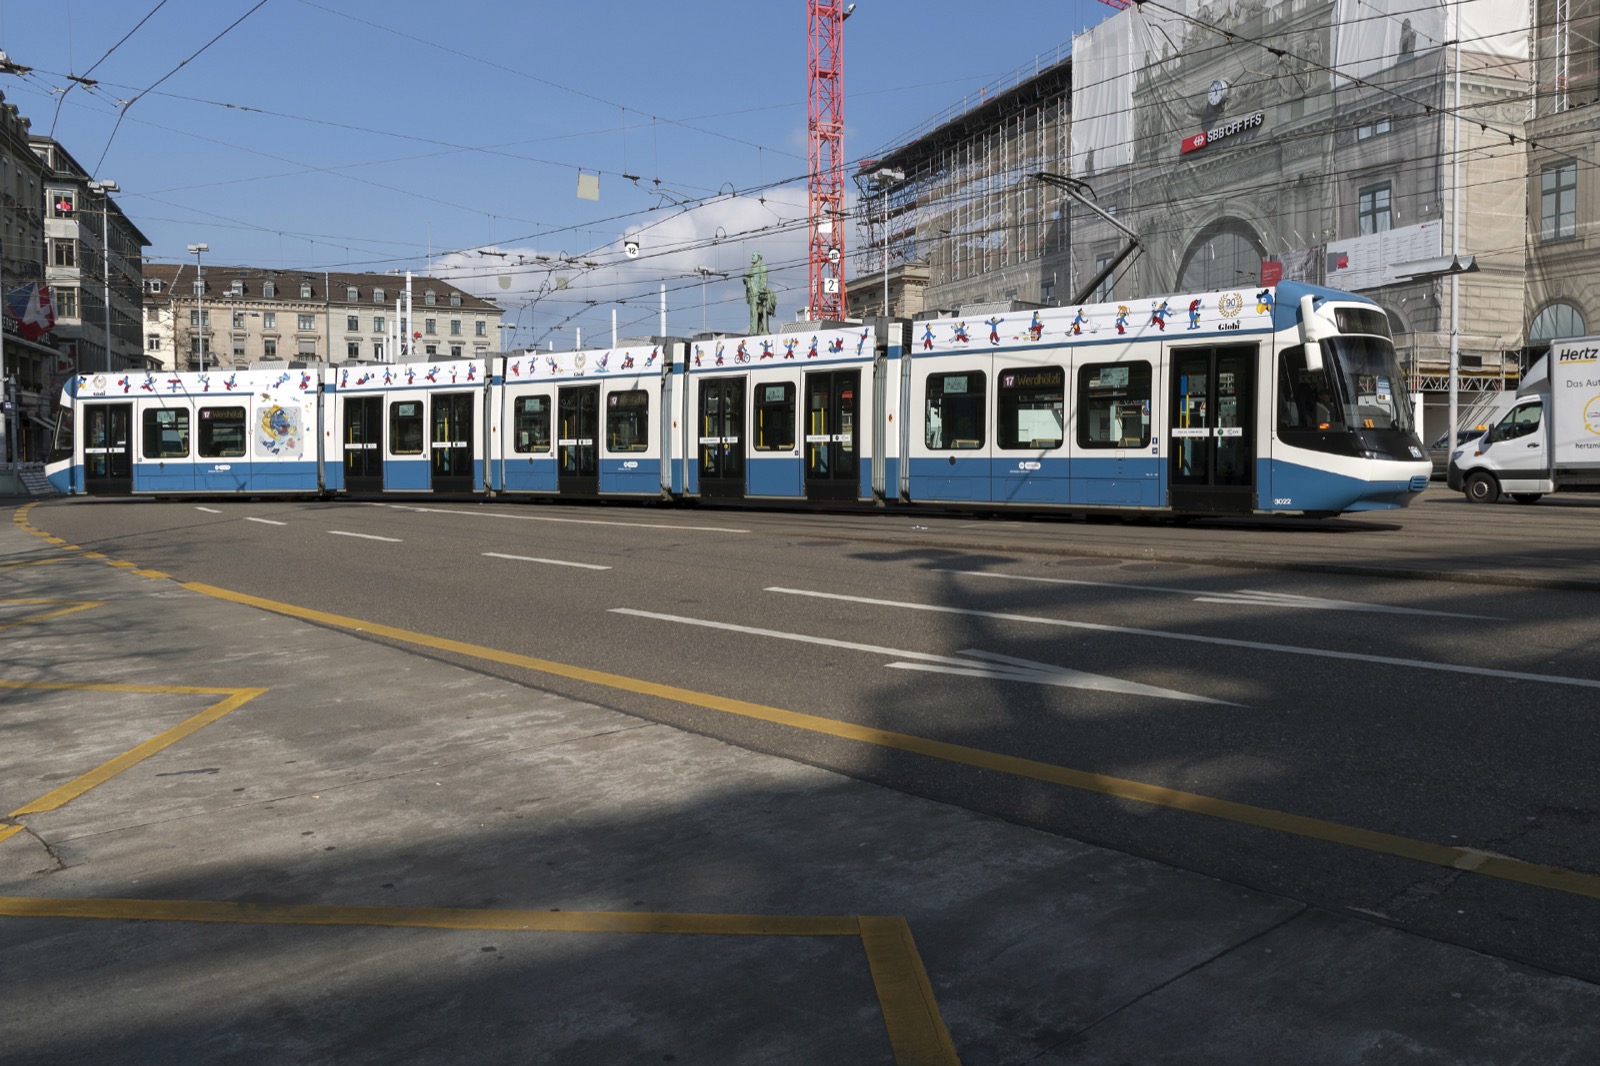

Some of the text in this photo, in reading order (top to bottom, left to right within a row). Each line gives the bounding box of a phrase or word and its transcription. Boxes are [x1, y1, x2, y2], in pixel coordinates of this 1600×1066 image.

[1207, 113, 1263, 142] SBB CFF FFS
[629, 247, 637, 255] 12
[828, 279, 835, 291] 2
[1226, 298, 1236, 307] 90
[1218, 319, 1240, 330] Globi
[1560, 347, 1599, 361] Hertz
[1005, 375, 1015, 386] 17
[1566, 380, 1583, 388] Das
